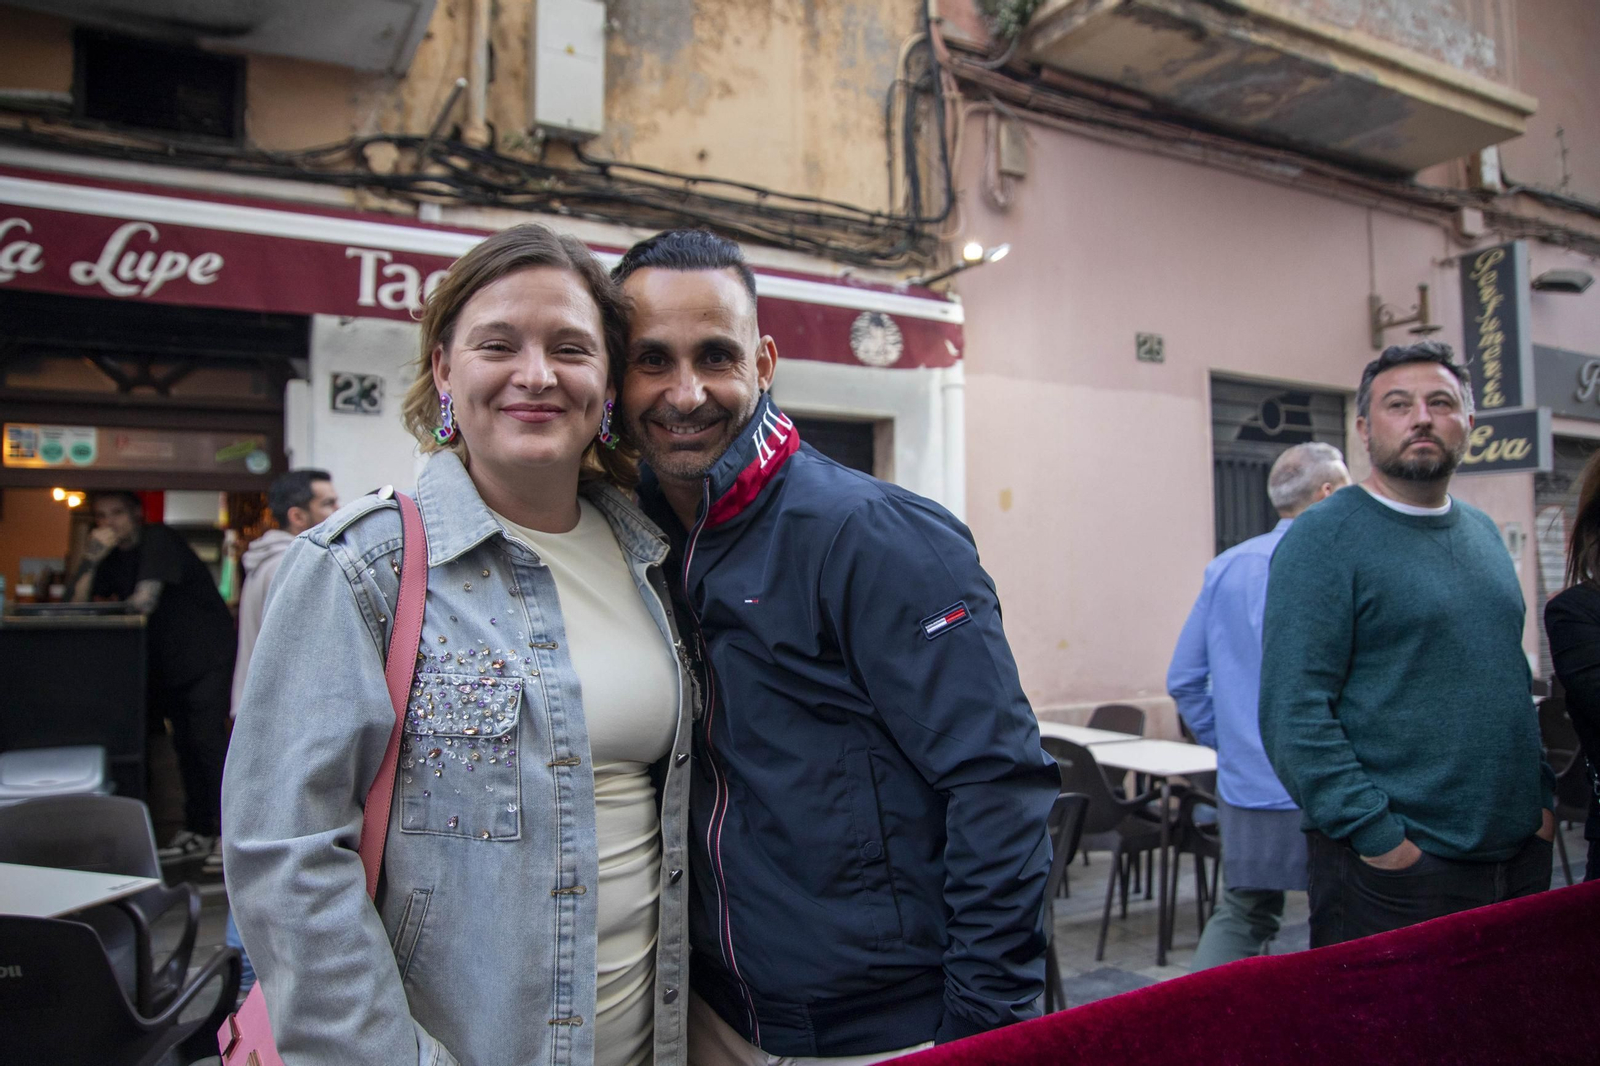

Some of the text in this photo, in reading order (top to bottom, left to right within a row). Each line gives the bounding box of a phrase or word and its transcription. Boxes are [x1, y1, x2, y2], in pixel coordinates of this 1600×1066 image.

[69, 221, 225, 297] Lupe
[334, 373, 381, 412] 23
[1462, 424, 1532, 465] Eva
